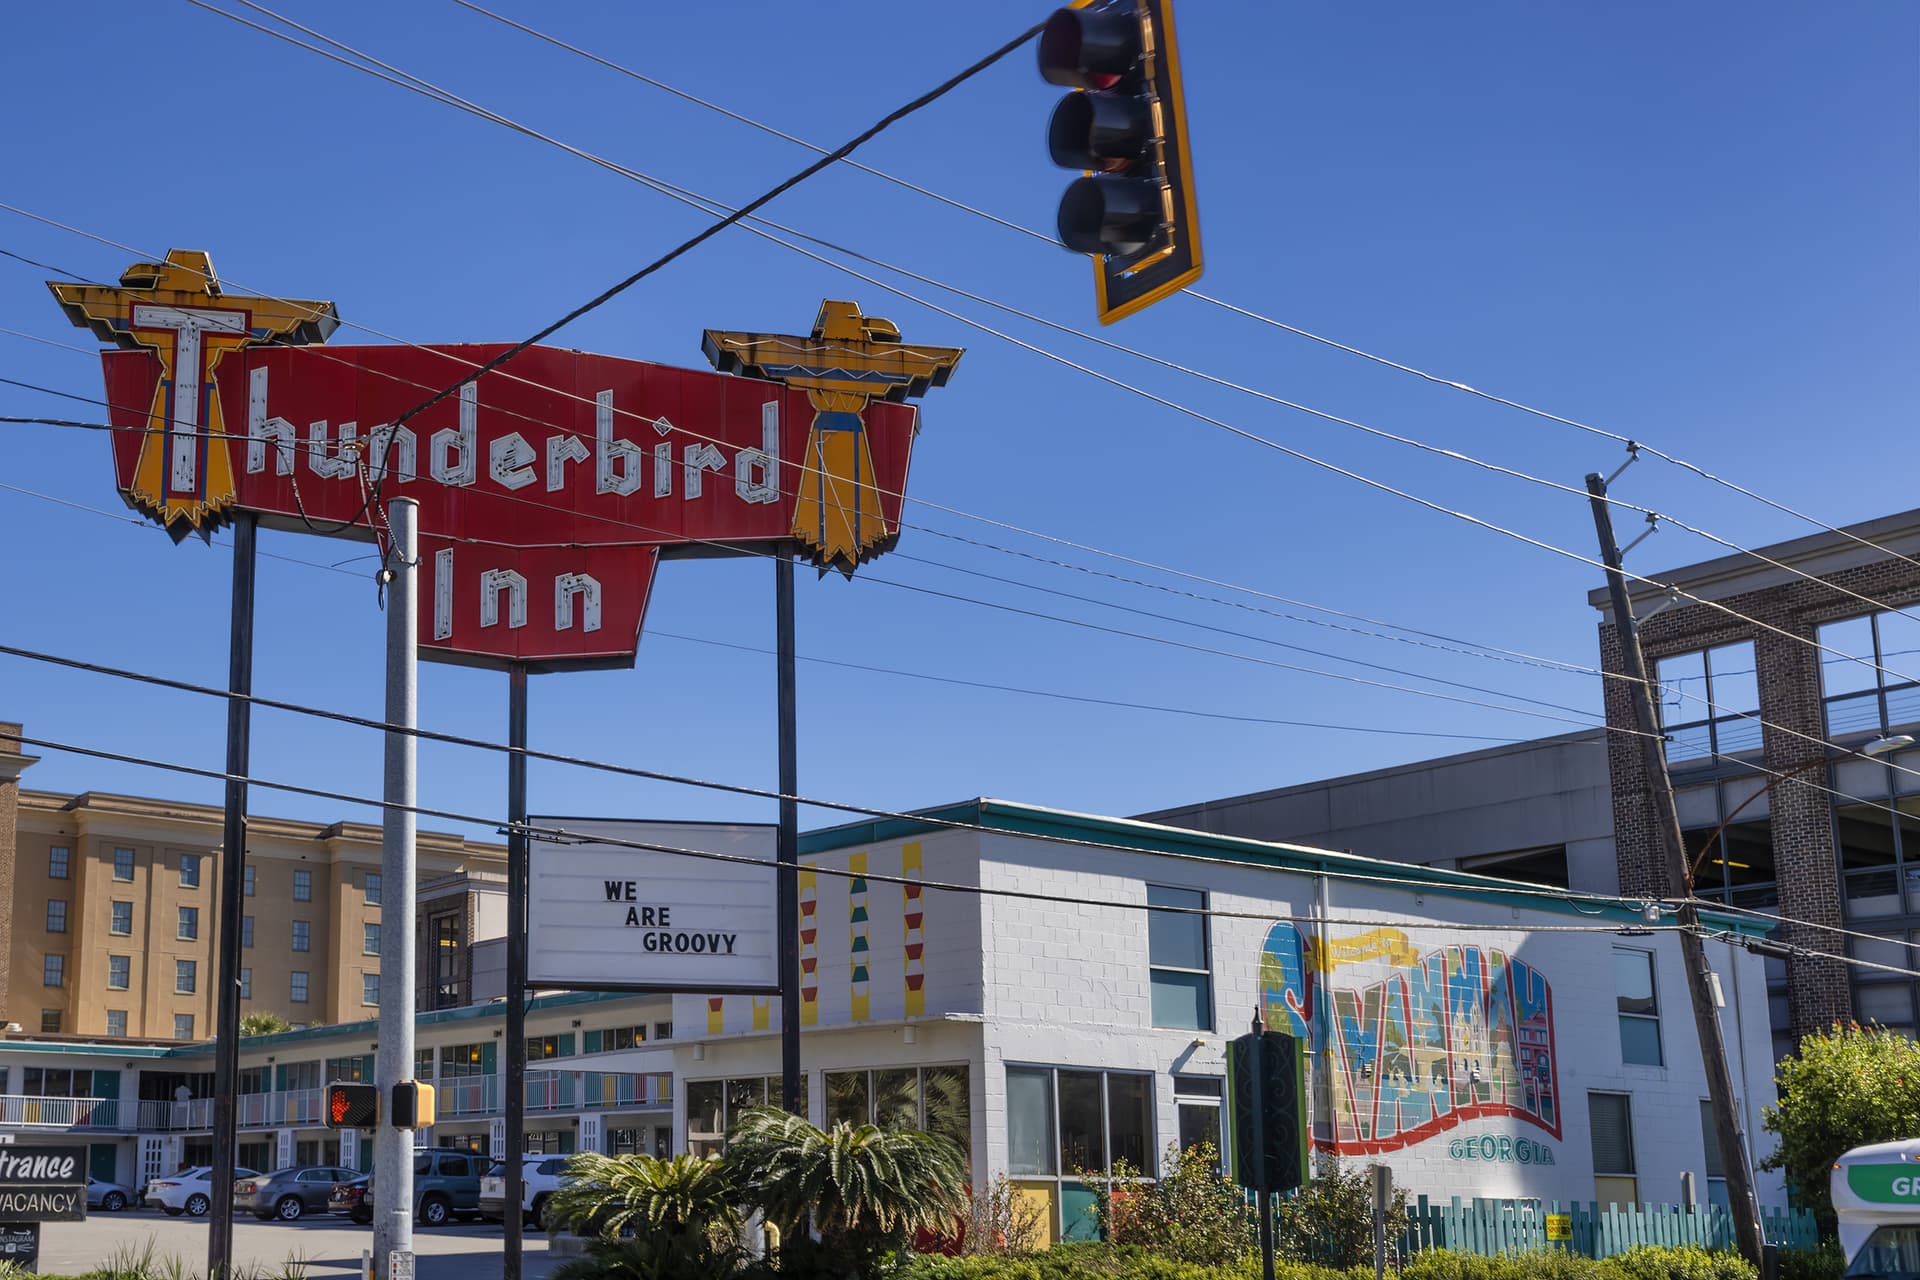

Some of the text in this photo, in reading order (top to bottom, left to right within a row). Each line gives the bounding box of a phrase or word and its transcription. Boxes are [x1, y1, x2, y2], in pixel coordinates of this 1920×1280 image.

[132, 303, 780, 505] Thunderbird
[434, 547, 602, 641] Inn
[604, 881, 637, 901] WE
[625, 907, 671, 927] ARE
[643, 932, 737, 954] GROOVY
[1448, 1133, 1556, 1166] GEORGIA
